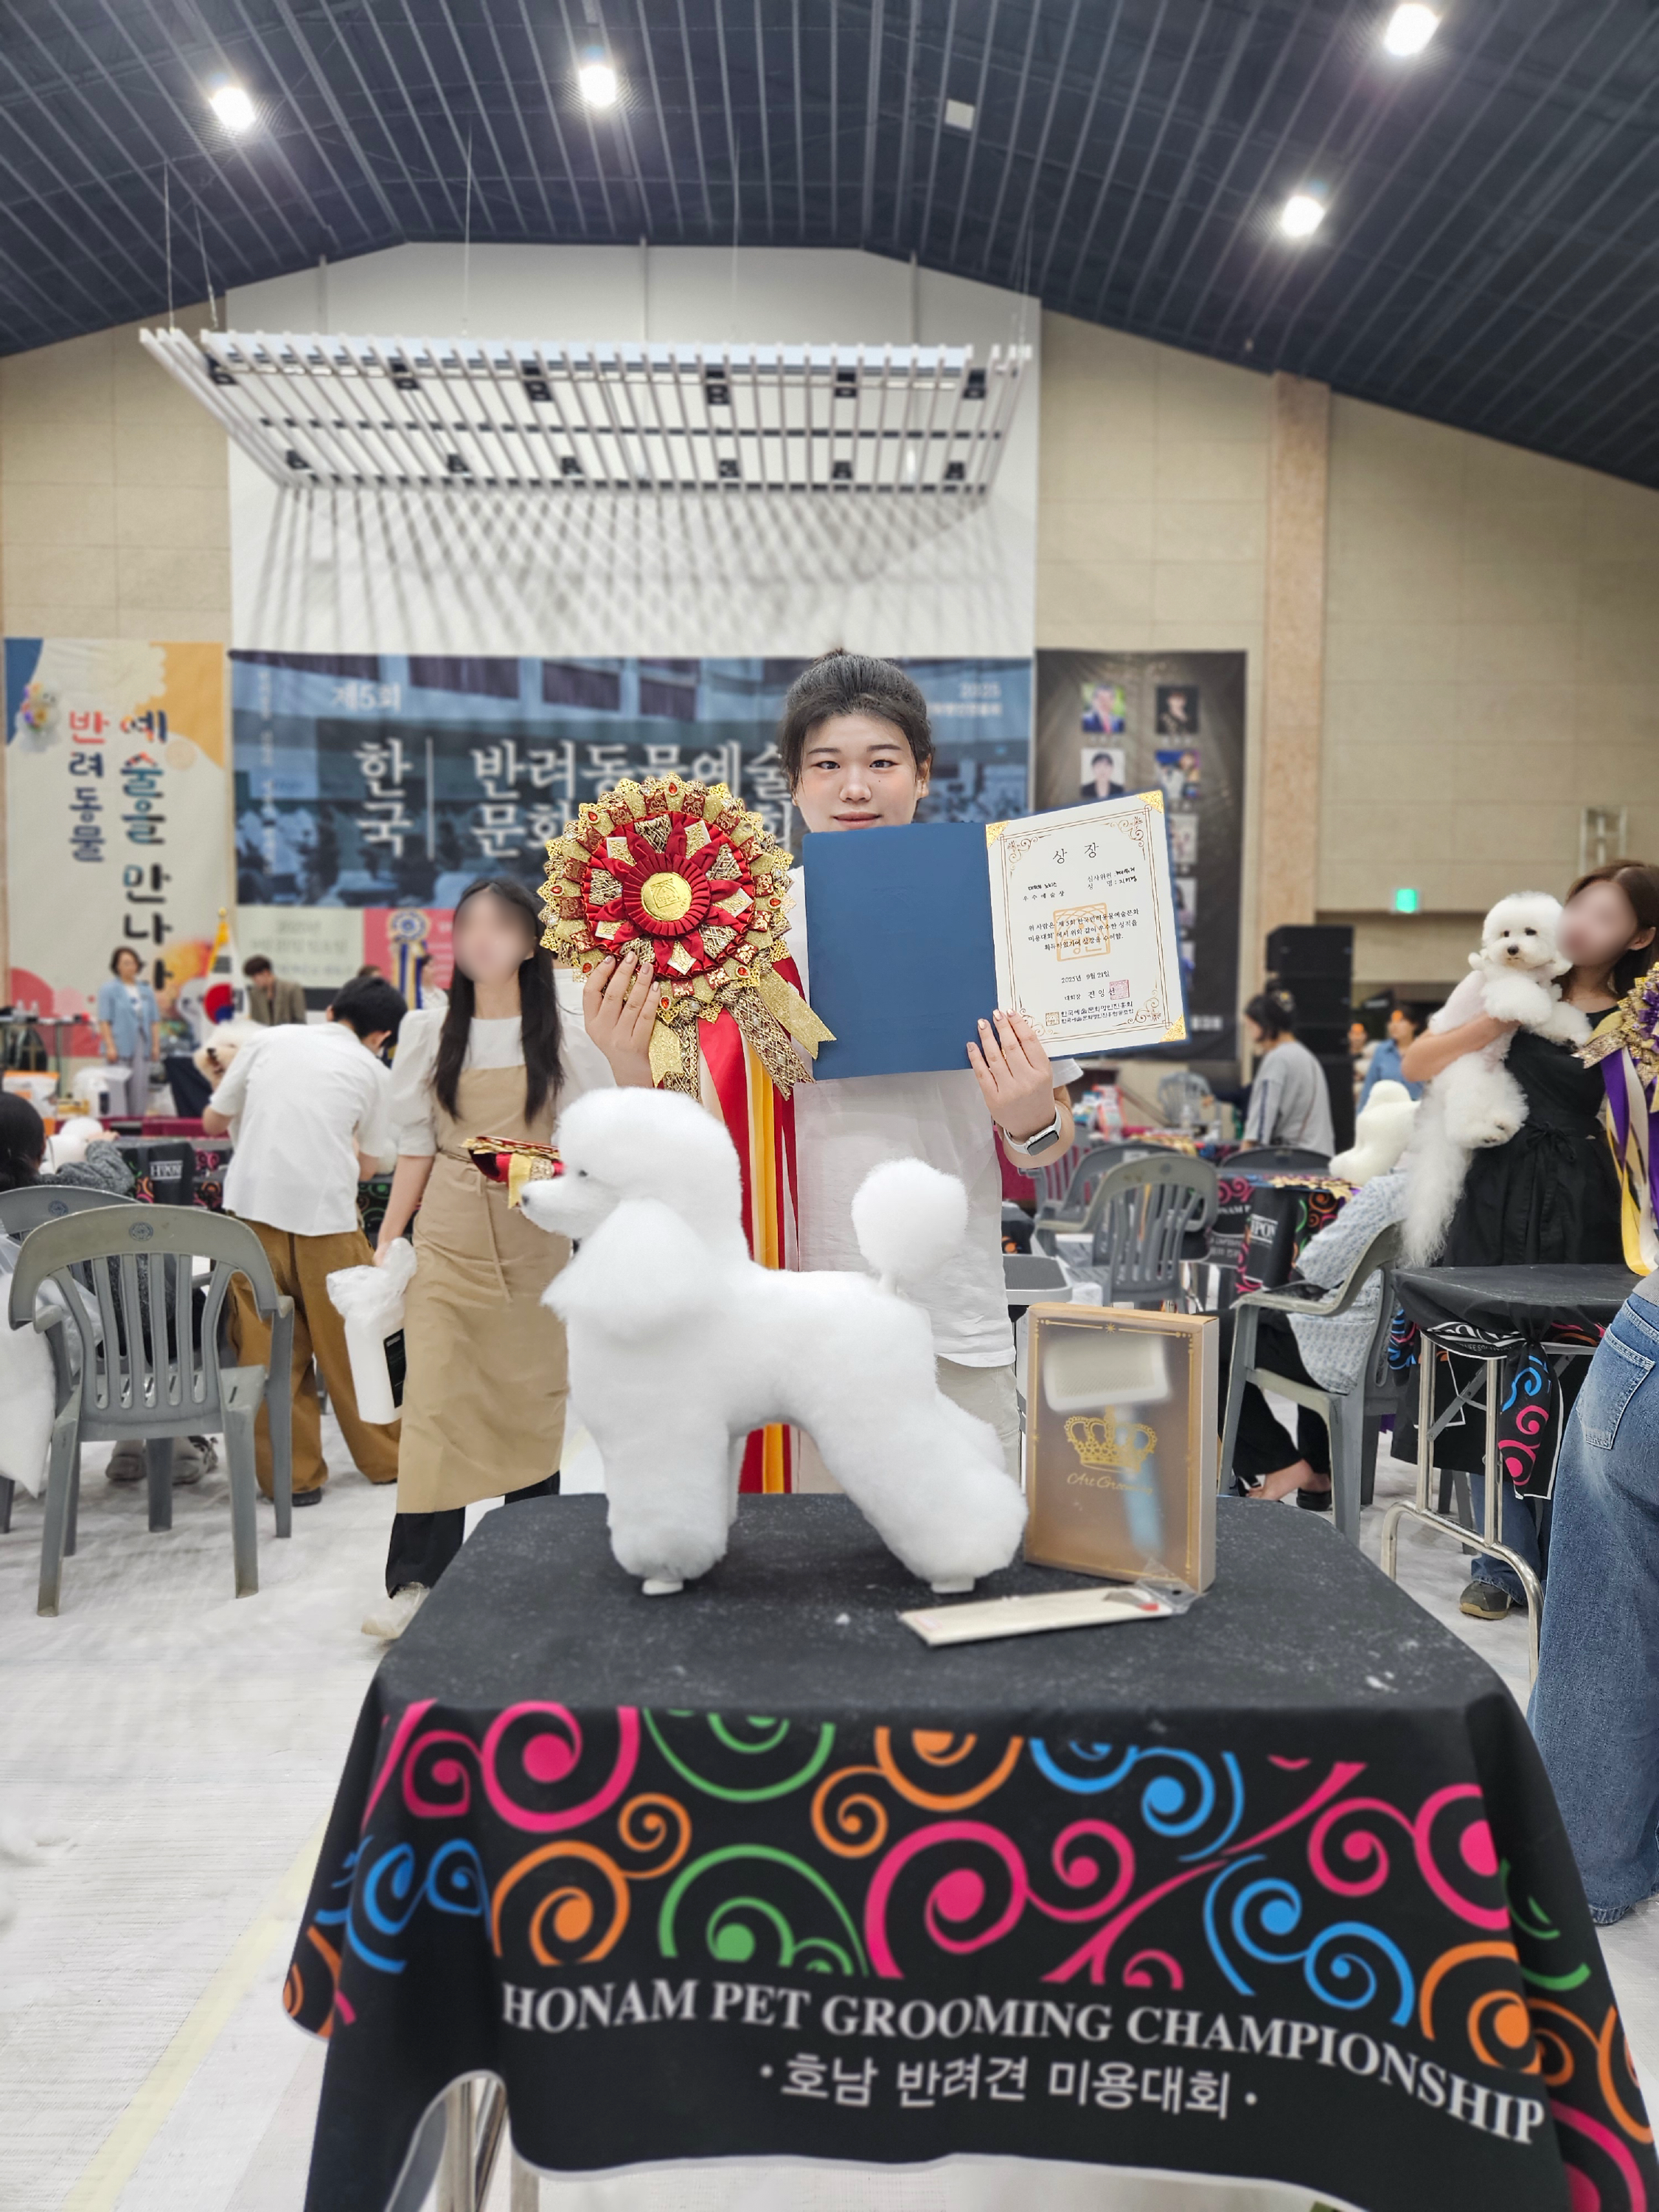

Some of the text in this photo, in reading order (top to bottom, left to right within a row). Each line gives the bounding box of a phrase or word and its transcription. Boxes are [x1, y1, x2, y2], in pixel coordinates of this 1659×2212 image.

[69, 709, 110, 863] 반려동물
[1061, 974, 1081, 984] 2025년
[502, 1978, 1545, 2145] HONAM PET GROOMING CHAMPIONSHIP
[781, 2052, 1231, 2121] 호남 반려견 미용대회
